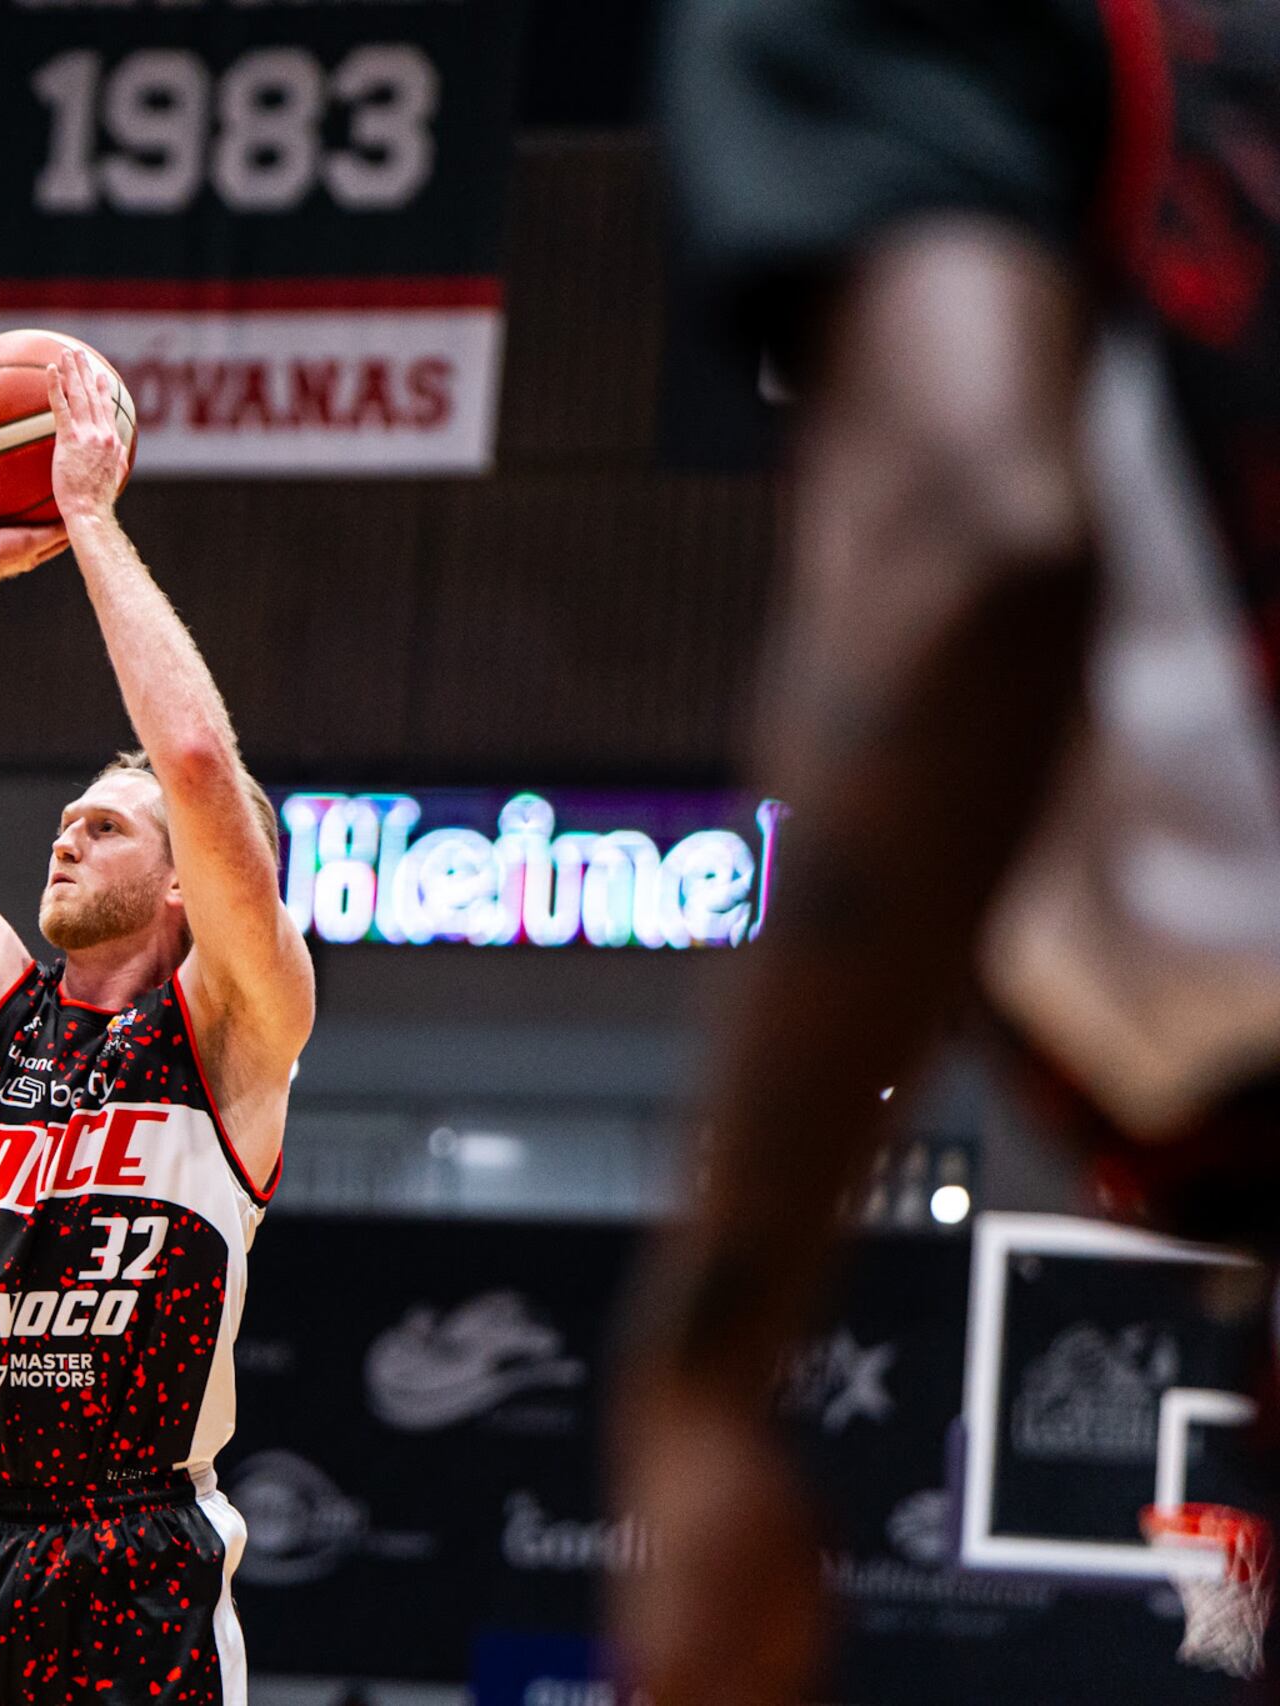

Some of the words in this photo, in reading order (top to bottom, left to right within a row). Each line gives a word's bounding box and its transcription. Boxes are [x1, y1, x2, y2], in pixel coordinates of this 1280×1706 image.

[30, 46, 439, 211] 1983
[120, 334, 456, 431] ÓVANAS
[78, 1216, 169, 1280] 32
[10, 1353, 93, 1370] MASTER
[10, 1371, 96, 1388] MOTORS
